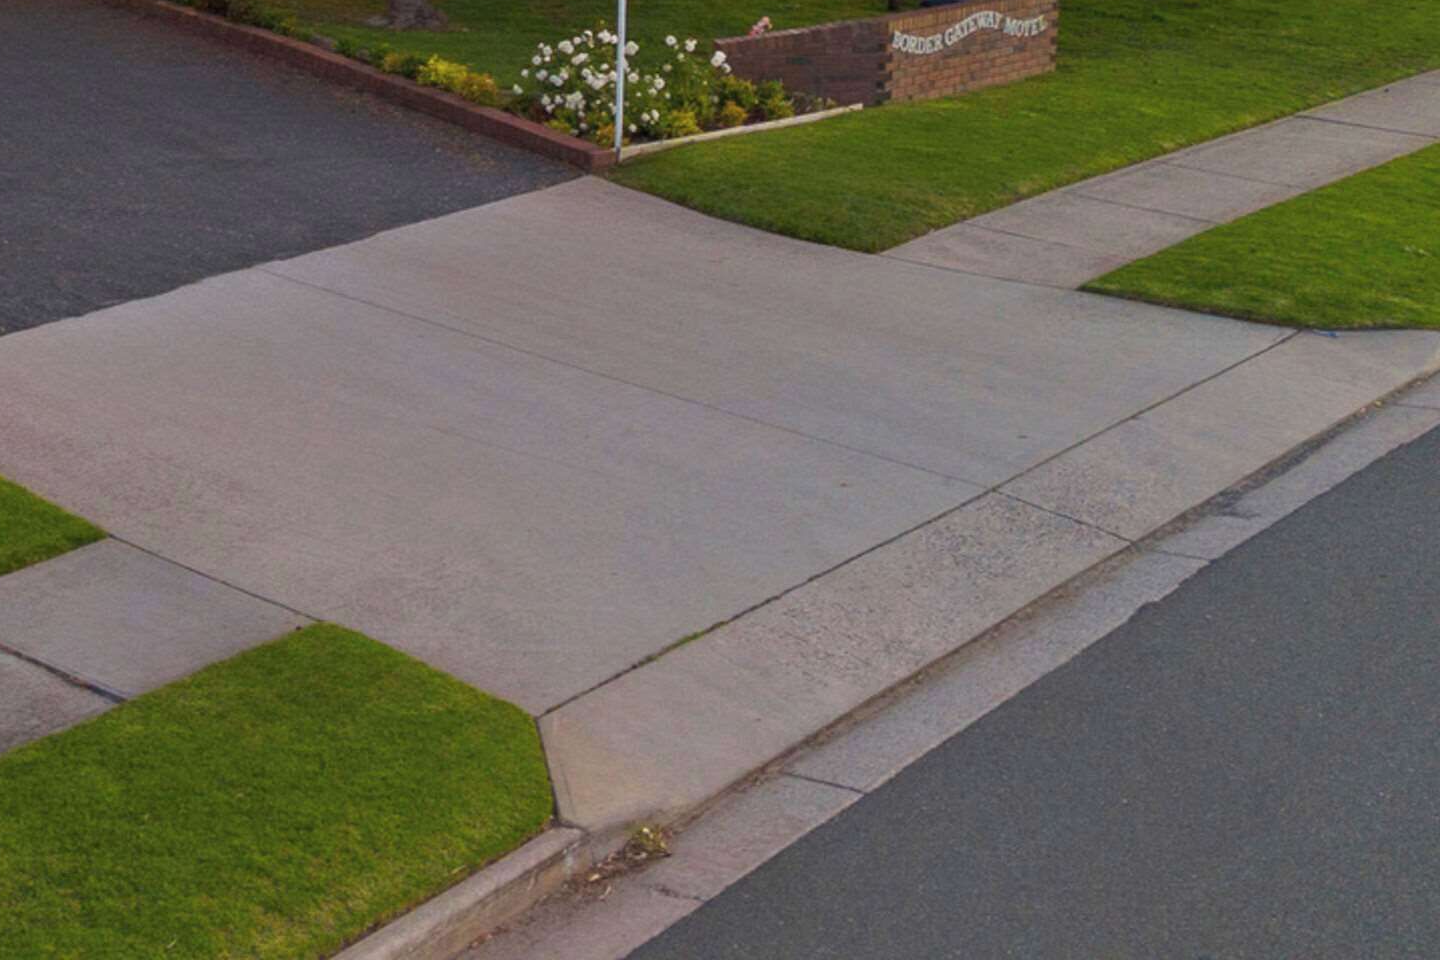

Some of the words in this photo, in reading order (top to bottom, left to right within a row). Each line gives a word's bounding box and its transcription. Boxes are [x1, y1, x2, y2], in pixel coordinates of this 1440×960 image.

[892, 30, 943, 55] BORDER
[944, 10, 1003, 47] GATEWAY
[1003, 15, 1048, 38] MOTEL
